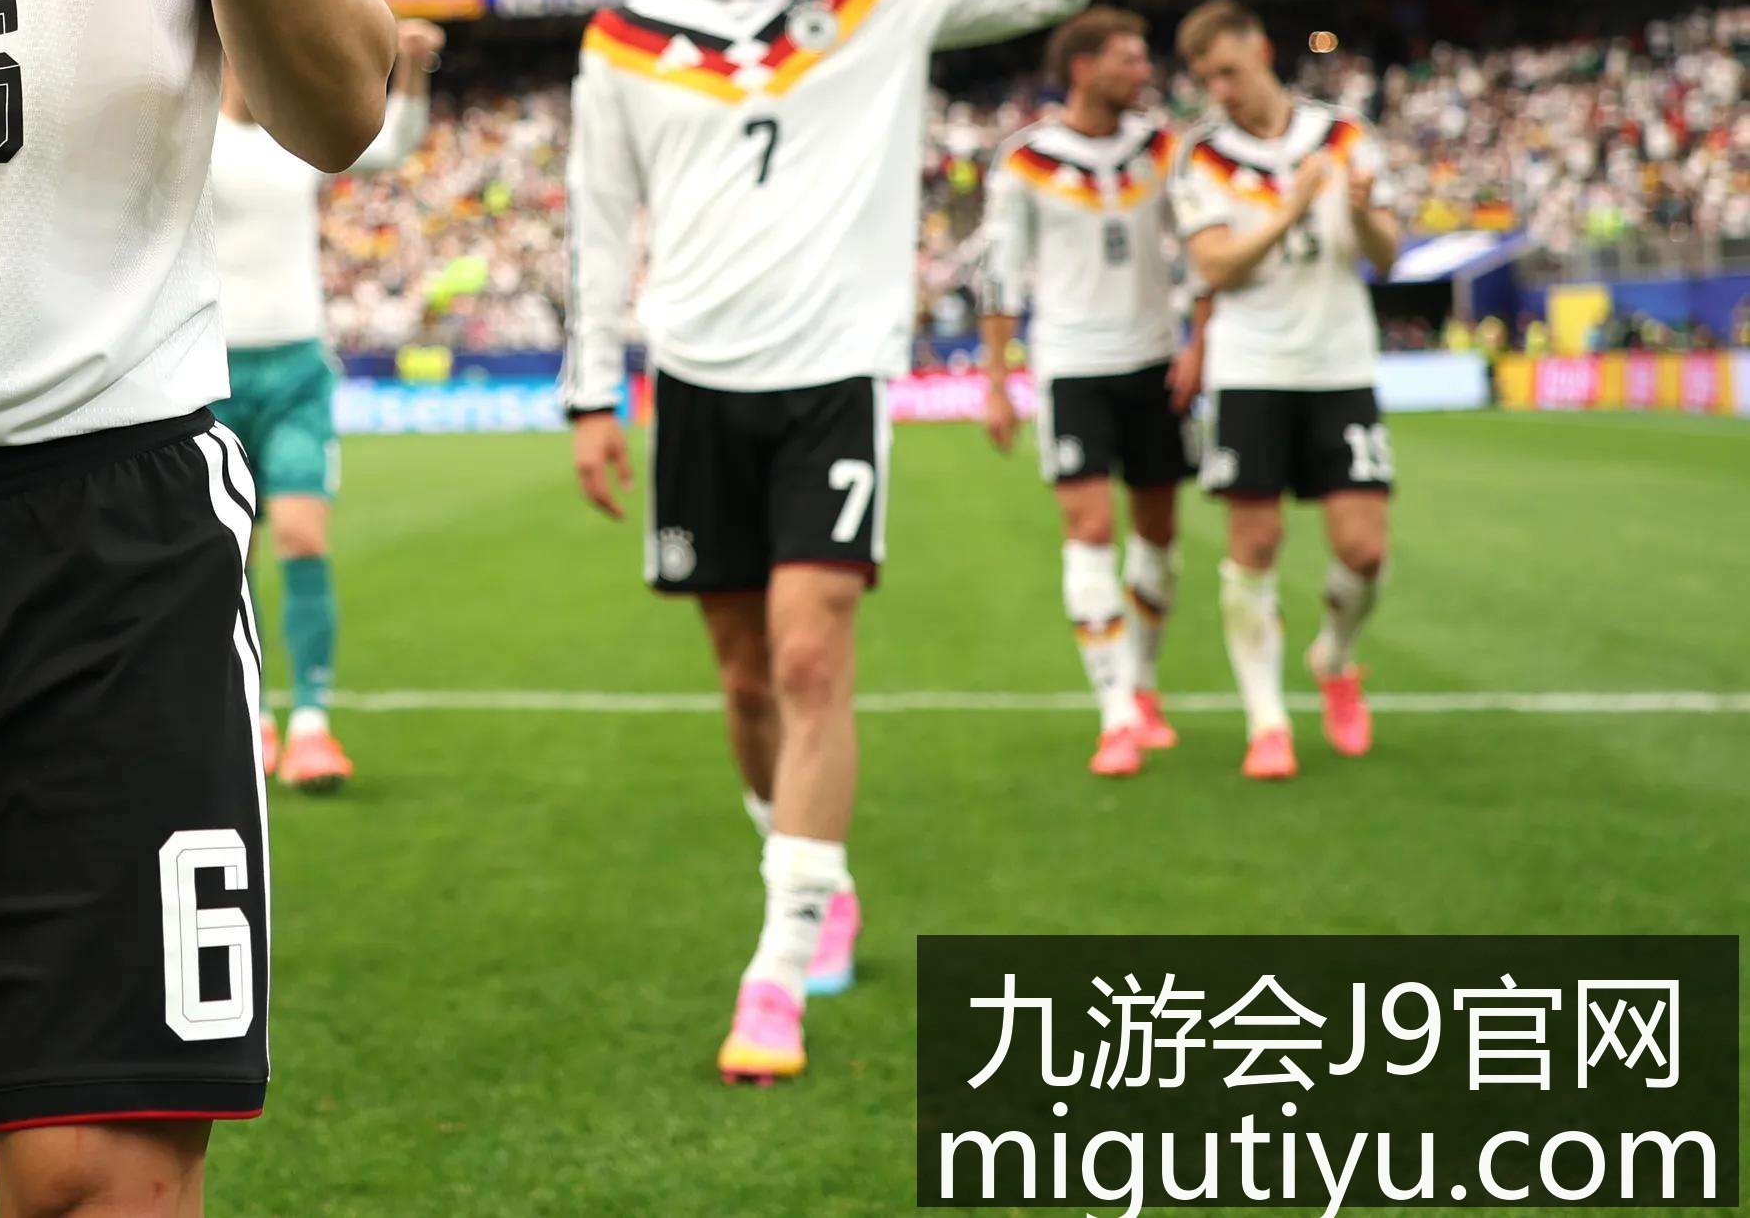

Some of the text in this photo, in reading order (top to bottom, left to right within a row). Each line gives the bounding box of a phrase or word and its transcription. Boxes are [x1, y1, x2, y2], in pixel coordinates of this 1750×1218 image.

[742, 118, 779, 185] 7
[828, 458, 875, 545] 7
[159, 828, 253, 1042] 6
